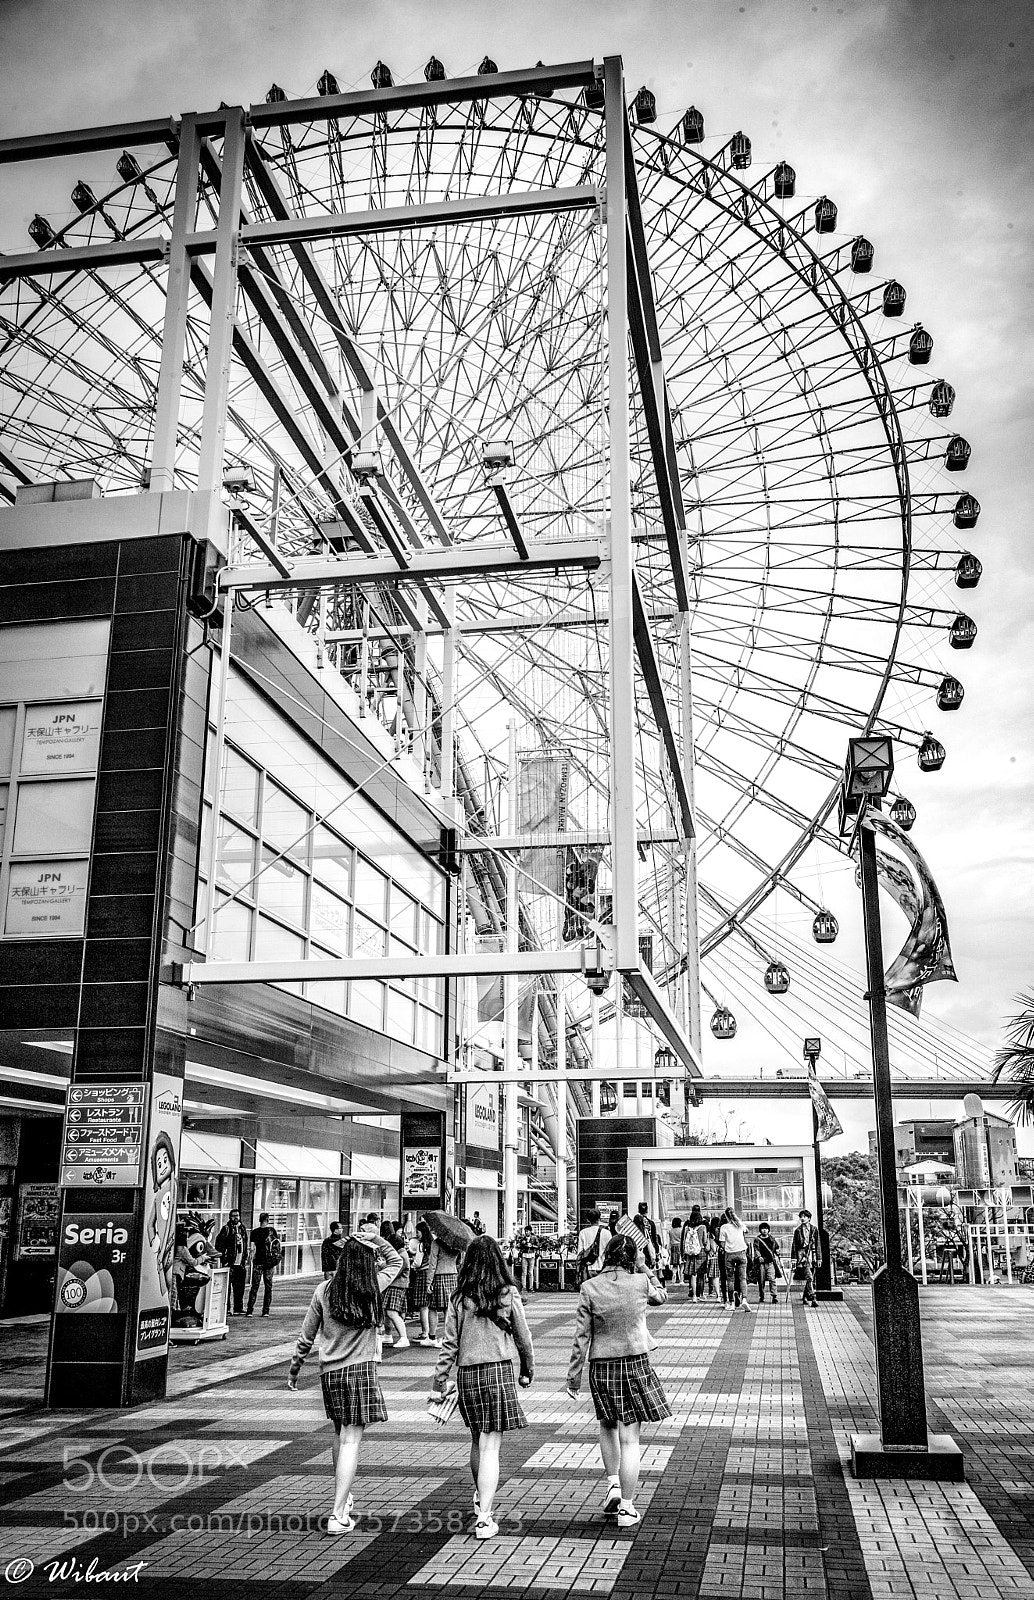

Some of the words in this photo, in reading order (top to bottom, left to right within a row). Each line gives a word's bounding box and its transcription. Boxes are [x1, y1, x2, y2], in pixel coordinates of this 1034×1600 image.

[52, 714, 76, 723] JPN
[27, 725, 99, 737] 天保山ギャラリー
[559, 762, 568, 803] TEMPOZAN
[37, 873, 62, 882] JPN
[11, 885, 85, 897] 天保山ギャラリー
[83, 1088, 129, 1097] ショッピング
[158, 1101, 181, 1112] LEGOLAND
[87, 1109, 124, 1117] レストラン
[474, 1103, 496, 1123] LEGOLAND
[80, 1128, 130, 1137] ファーストフード
[79, 1147, 126, 1157] アミューズメント
[64, 1222, 128, 1245] Seria
[111, 1249, 127, 1263] 3F
[65, 1287, 82, 1299] 100
